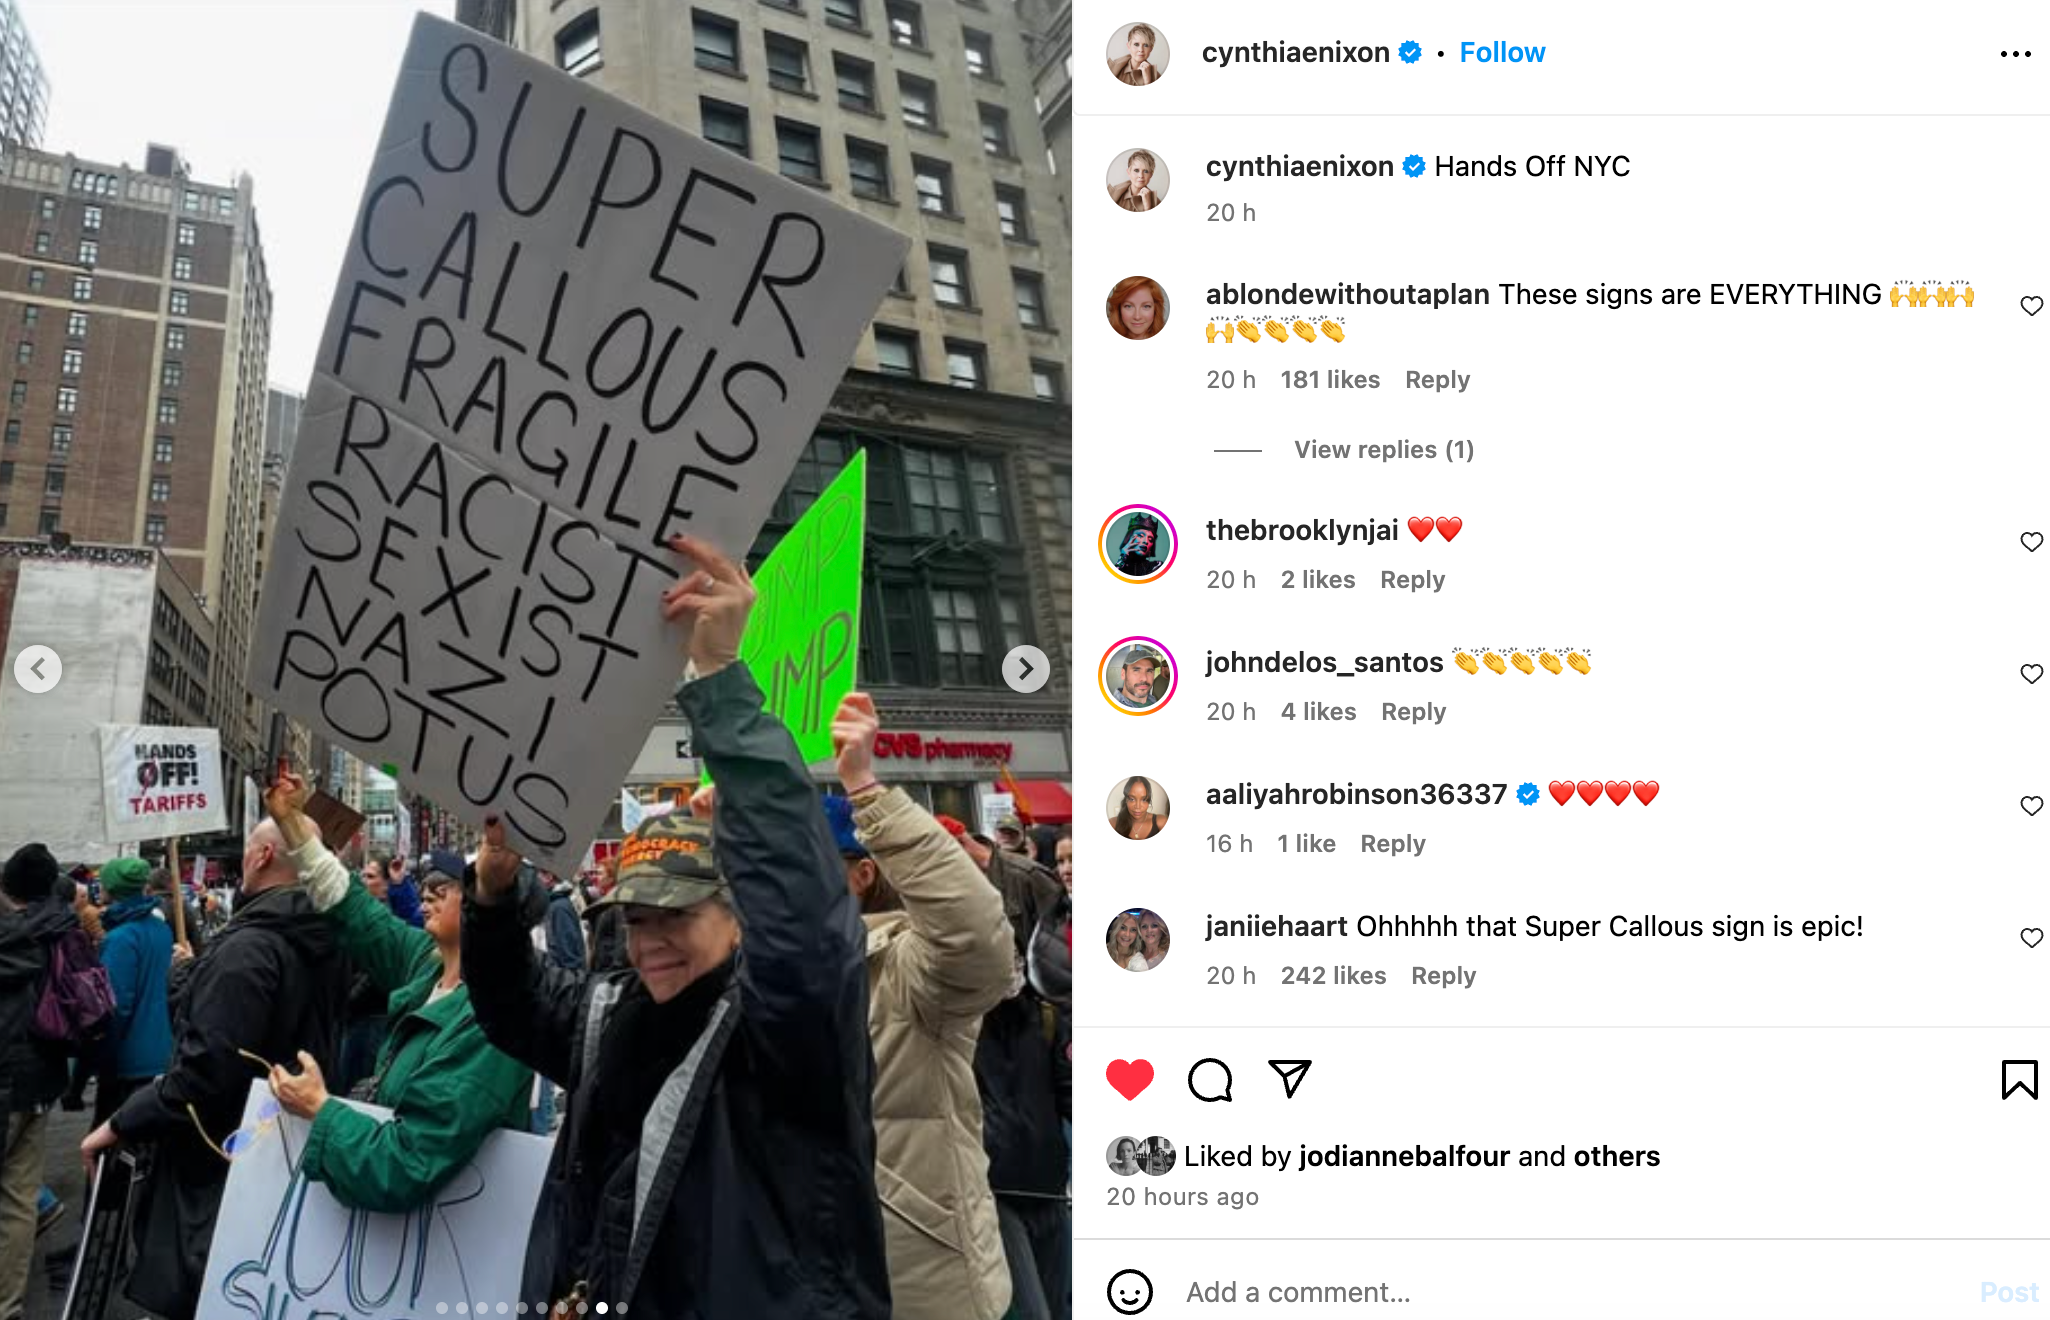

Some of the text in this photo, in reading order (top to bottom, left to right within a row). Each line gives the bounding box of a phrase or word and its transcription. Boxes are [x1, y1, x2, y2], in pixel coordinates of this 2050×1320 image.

[1203, 40, 1546, 68] cynthiaenixon Follow
[1207, 154, 1630, 182] cynthiaenixon Hands Off NYC
[421, 43, 826, 359] SUPER
[1207, 203, 1255, 222] 20 h
[1207, 282, 1881, 310] ablondewithoutaplan These signs are EVERYTHING
[361, 175, 788, 467] CALLOUS
[1207, 369, 1470, 393] 20 h 181 likes Reply
[332, 279, 740, 549] FRAGILE
[1295, 439, 1473, 462] View replies (1)
[333, 394, 682, 638] RACIST
[1206, 518, 1398, 546] thebrooklynjai
[296, 480, 639, 703] SEXIST
[1207, 569, 1445, 593] 20 h 2 likes Reply
[297, 564, 556, 762] NAZI
[1205, 650, 1443, 677] johndelos_santos
[1207, 701, 1446, 725] 20 h 4 likes Reply
[273, 629, 569, 847] POTUS
[874, 732, 1013, 763] CVS pharmacy
[134, 744, 197, 760] HANDS
[137, 761, 199, 789] OFF!
[128, 793, 208, 815] TARIFFS
[1207, 782, 1507, 810] aaliyahrobinson36337
[1207, 833, 1426, 857] 16 h 1 like Reply
[1205, 914, 1862, 941] janiiehaart Ohhhhh that Super Callous sign is epic!
[1207, 965, 1476, 989] 20 h 242 likes Reply
[1186, 1144, 1660, 1171] Liked by jodiannebalfour and others
[1107, 1187, 1259, 1210] 20 hours ago
[1186, 1281, 1236, 1302] Add
[1246, 1286, 1259, 1302] a
[1981, 1282, 2039, 1303] Post
